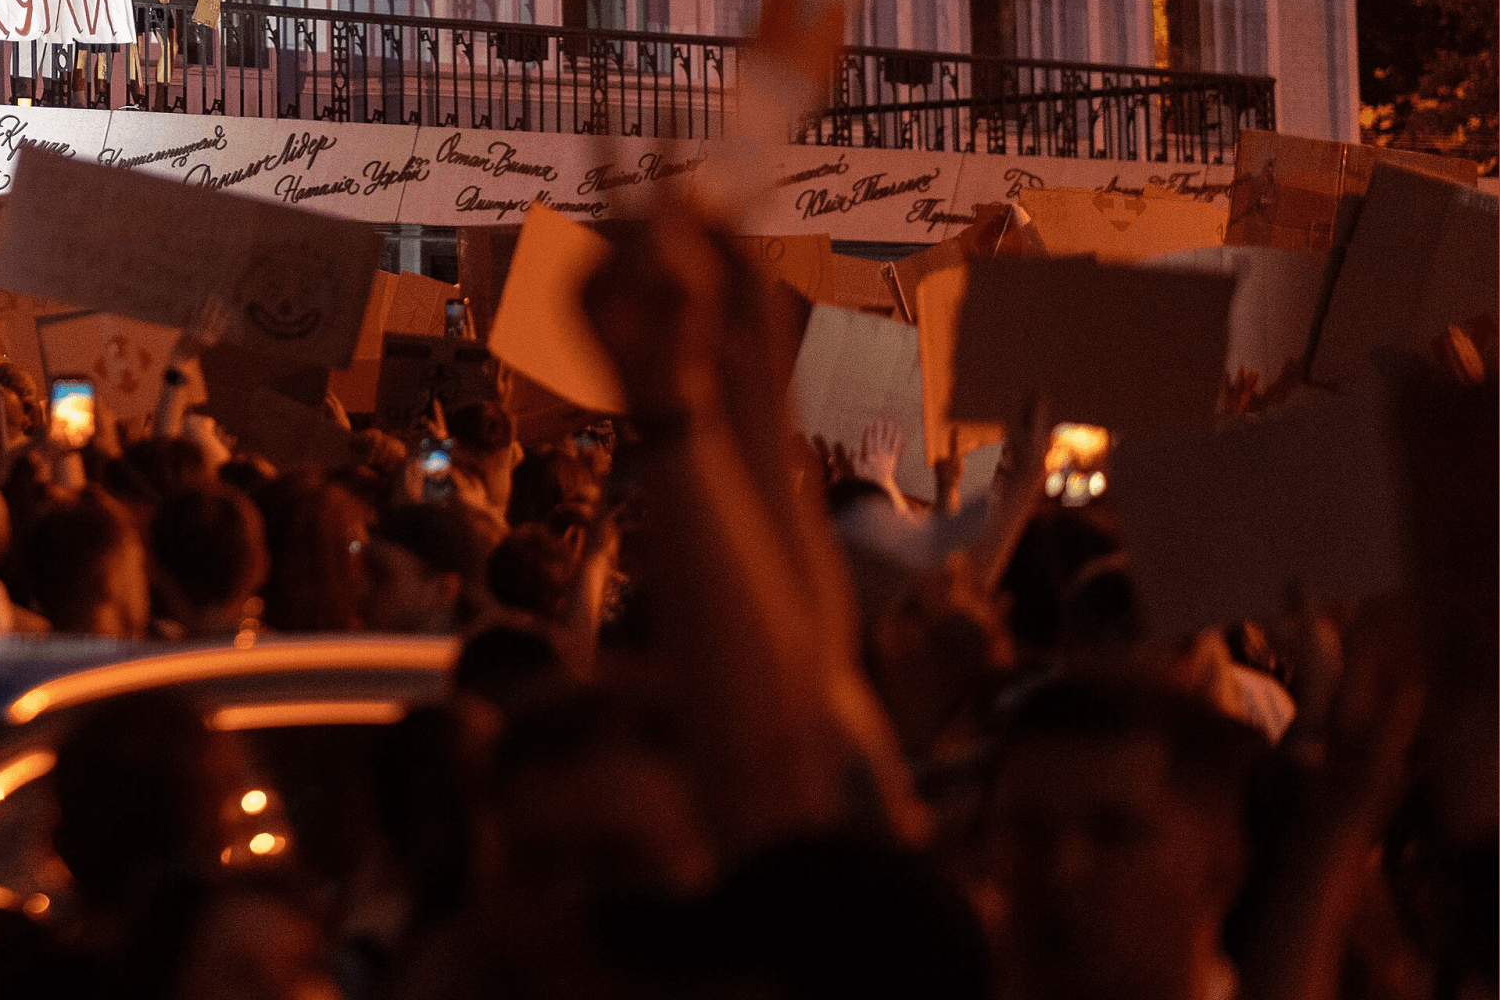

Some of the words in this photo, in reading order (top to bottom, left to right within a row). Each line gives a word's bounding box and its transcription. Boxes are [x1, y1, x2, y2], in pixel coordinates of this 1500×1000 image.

[264, 132, 338, 170] Лідер
[436, 132, 495, 171] Остап
[487, 141, 559, 182] Вишня
[274, 175, 360, 204] Наталія
